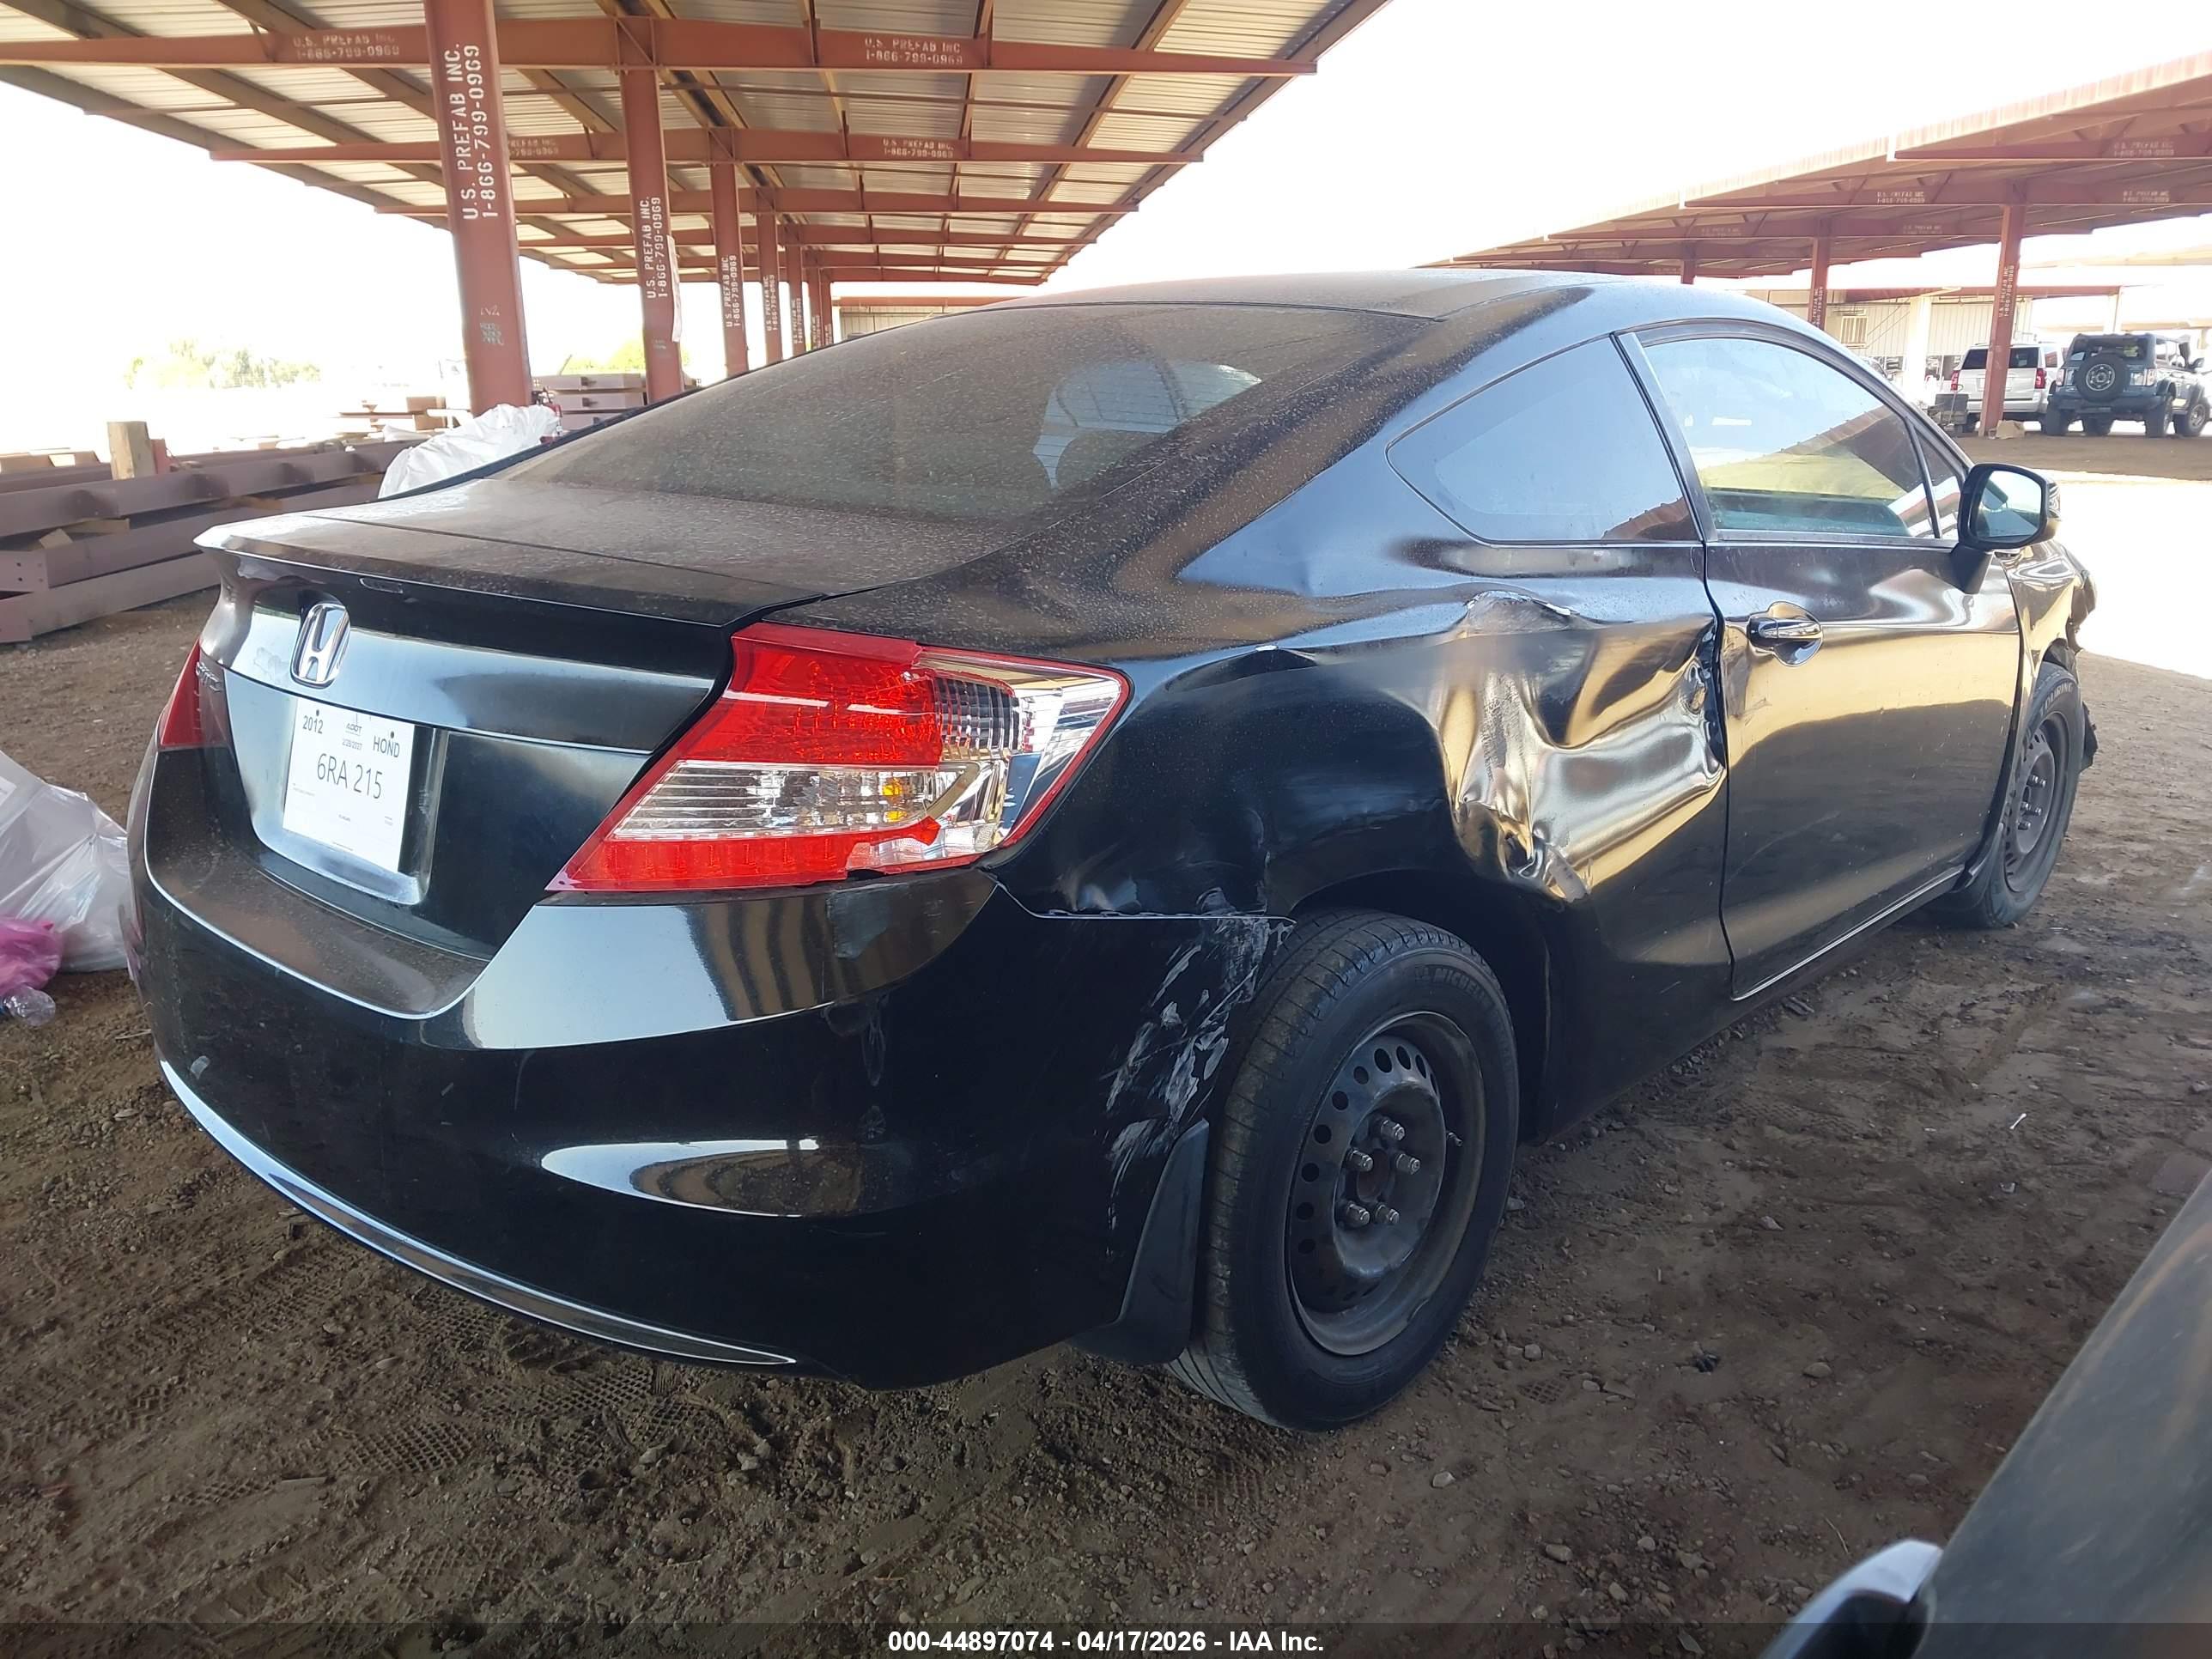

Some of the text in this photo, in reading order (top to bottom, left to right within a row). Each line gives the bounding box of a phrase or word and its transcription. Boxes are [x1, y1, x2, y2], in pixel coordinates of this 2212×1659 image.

[892, 39, 937, 52] PREFAB
[444, 44, 479, 220] U.S. PREFAB INC.
[464, 45, 498, 218] 1-866-799-0969
[639, 197, 657, 299] U.S. PREFAB INC.
[651, 197, 668, 298] 1-866-799-0969
[302, 715, 324, 734] 2012
[373, 735, 400, 757] HOND
[317, 753, 347, 788] 6RA
[354, 764, 383, 799] 215
